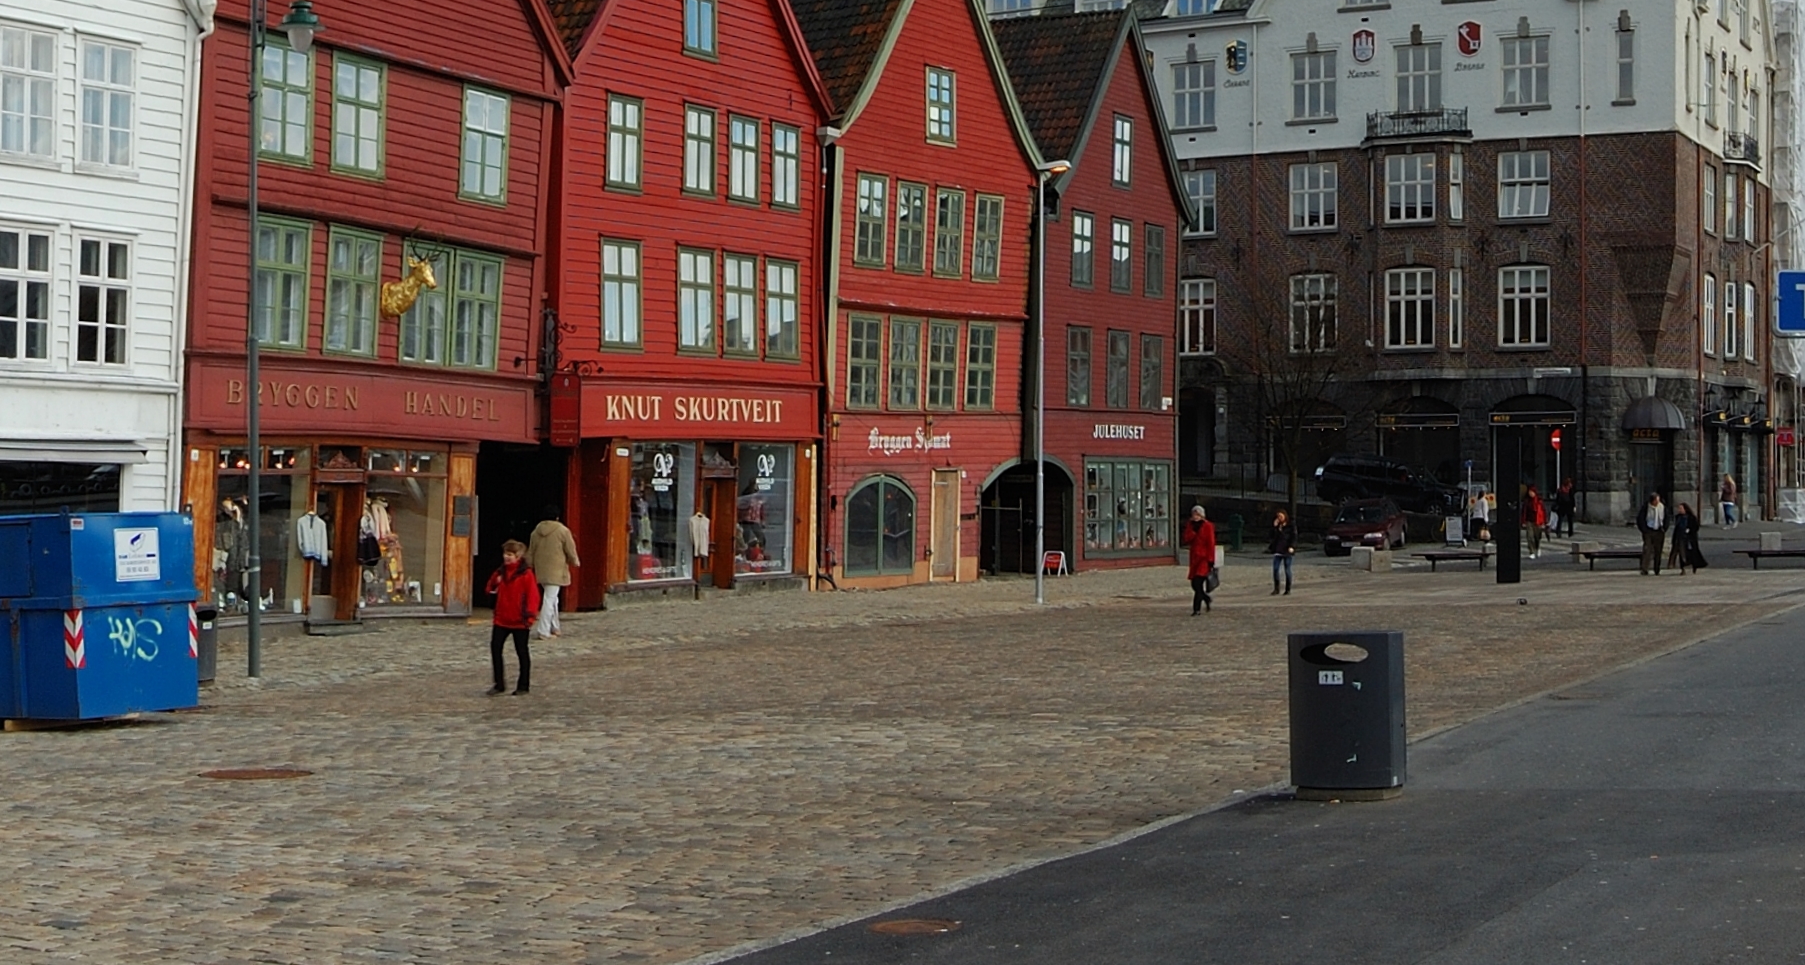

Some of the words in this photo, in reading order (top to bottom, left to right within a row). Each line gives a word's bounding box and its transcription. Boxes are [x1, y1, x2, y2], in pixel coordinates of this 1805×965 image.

[404, 390, 500, 422] HANDEL
[606, 395, 662, 421] KNUT
[674, 396, 783, 423] SKURTVEIT
[1093, 424, 1145, 440] JULEHUSET
